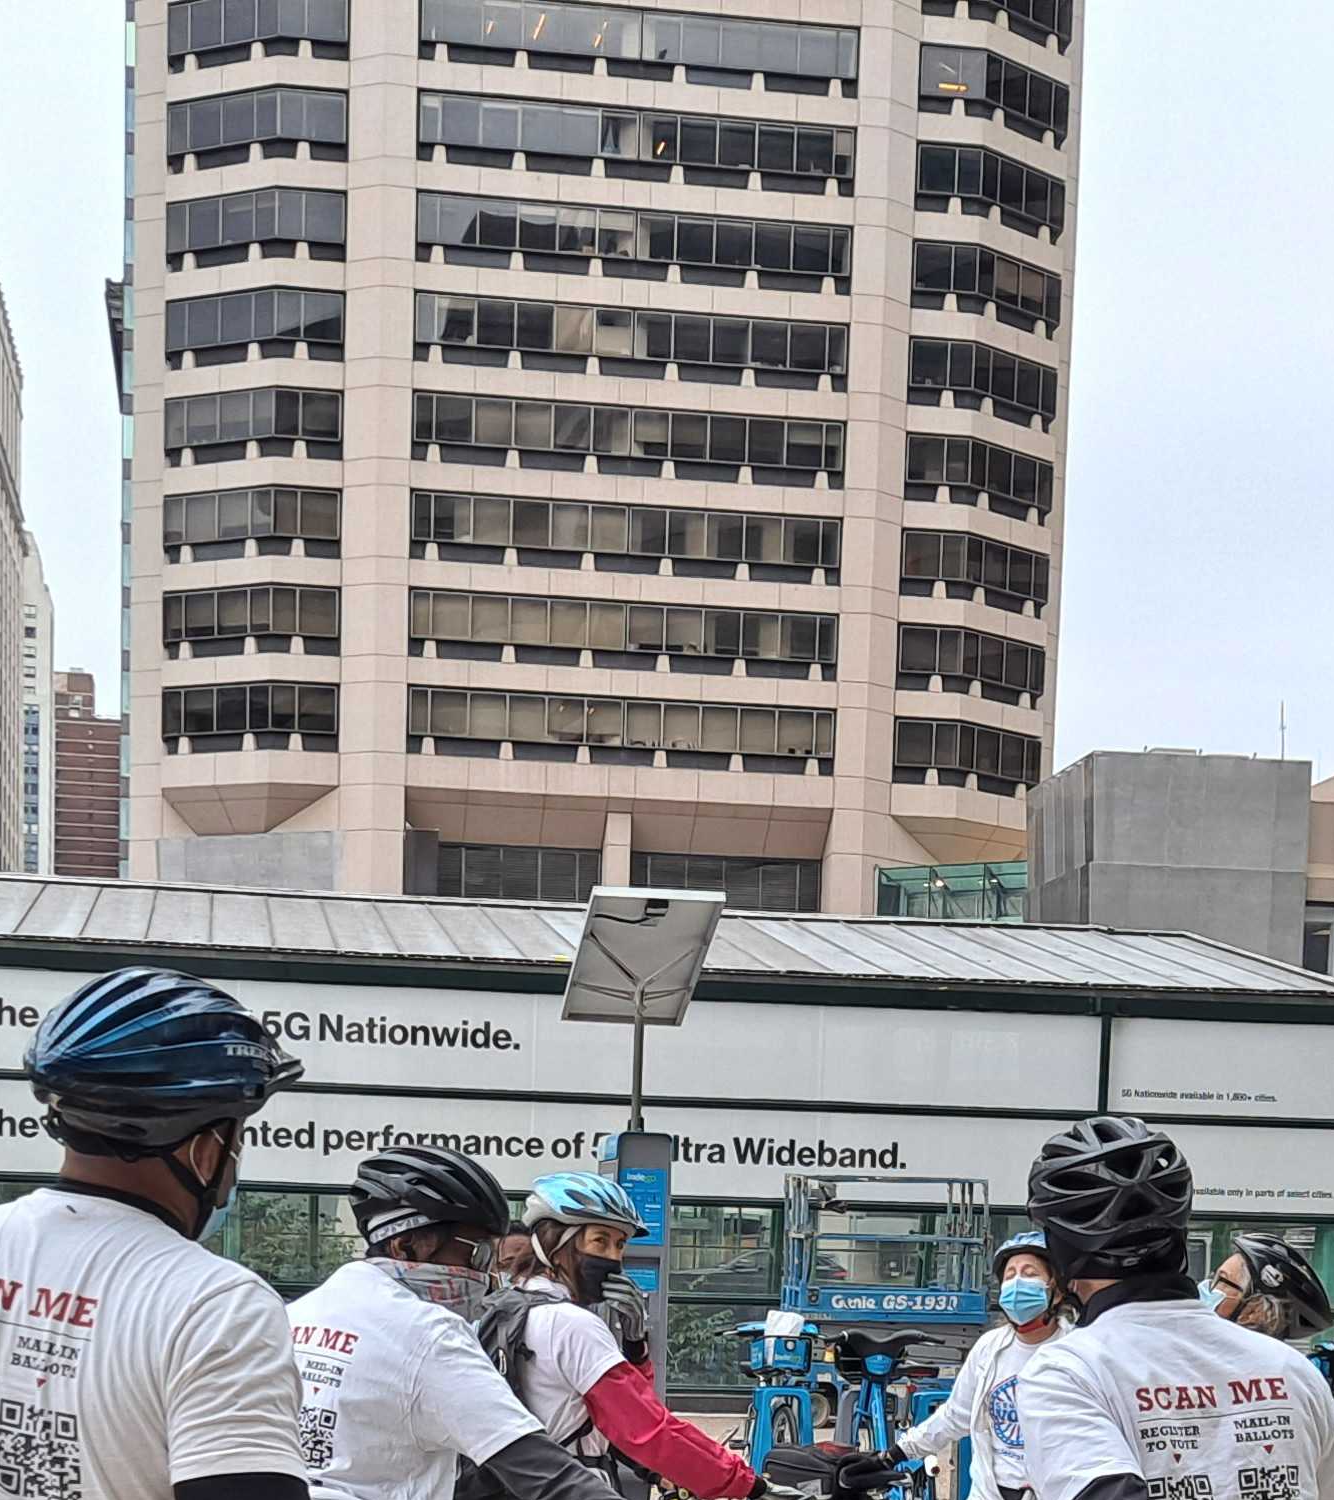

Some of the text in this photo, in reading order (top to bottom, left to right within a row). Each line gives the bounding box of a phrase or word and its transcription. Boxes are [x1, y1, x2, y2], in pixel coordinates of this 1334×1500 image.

[262, 1010, 311, 1041] 5G
[317, 1013, 522, 1052] Nationwide.
[1134, 1089, 1178, 1100] Nationwide
[1179, 1090, 1214, 1100] available
[551, 1129, 588, 1160] of
[672, 1133, 726, 1164] ltra
[733, 1136, 908, 1171] Wideband.
[29, 1285, 99, 1329] ME
[317, 1328, 359, 1355] ME
[1136, 1377, 1289, 1413] SCAN ME
[1233, 1415, 1291, 1430] MAIL-IN
[1235, 1428, 1295, 1443] BALLOTS
[1146, 1438, 1199, 1453] TO VOTE
